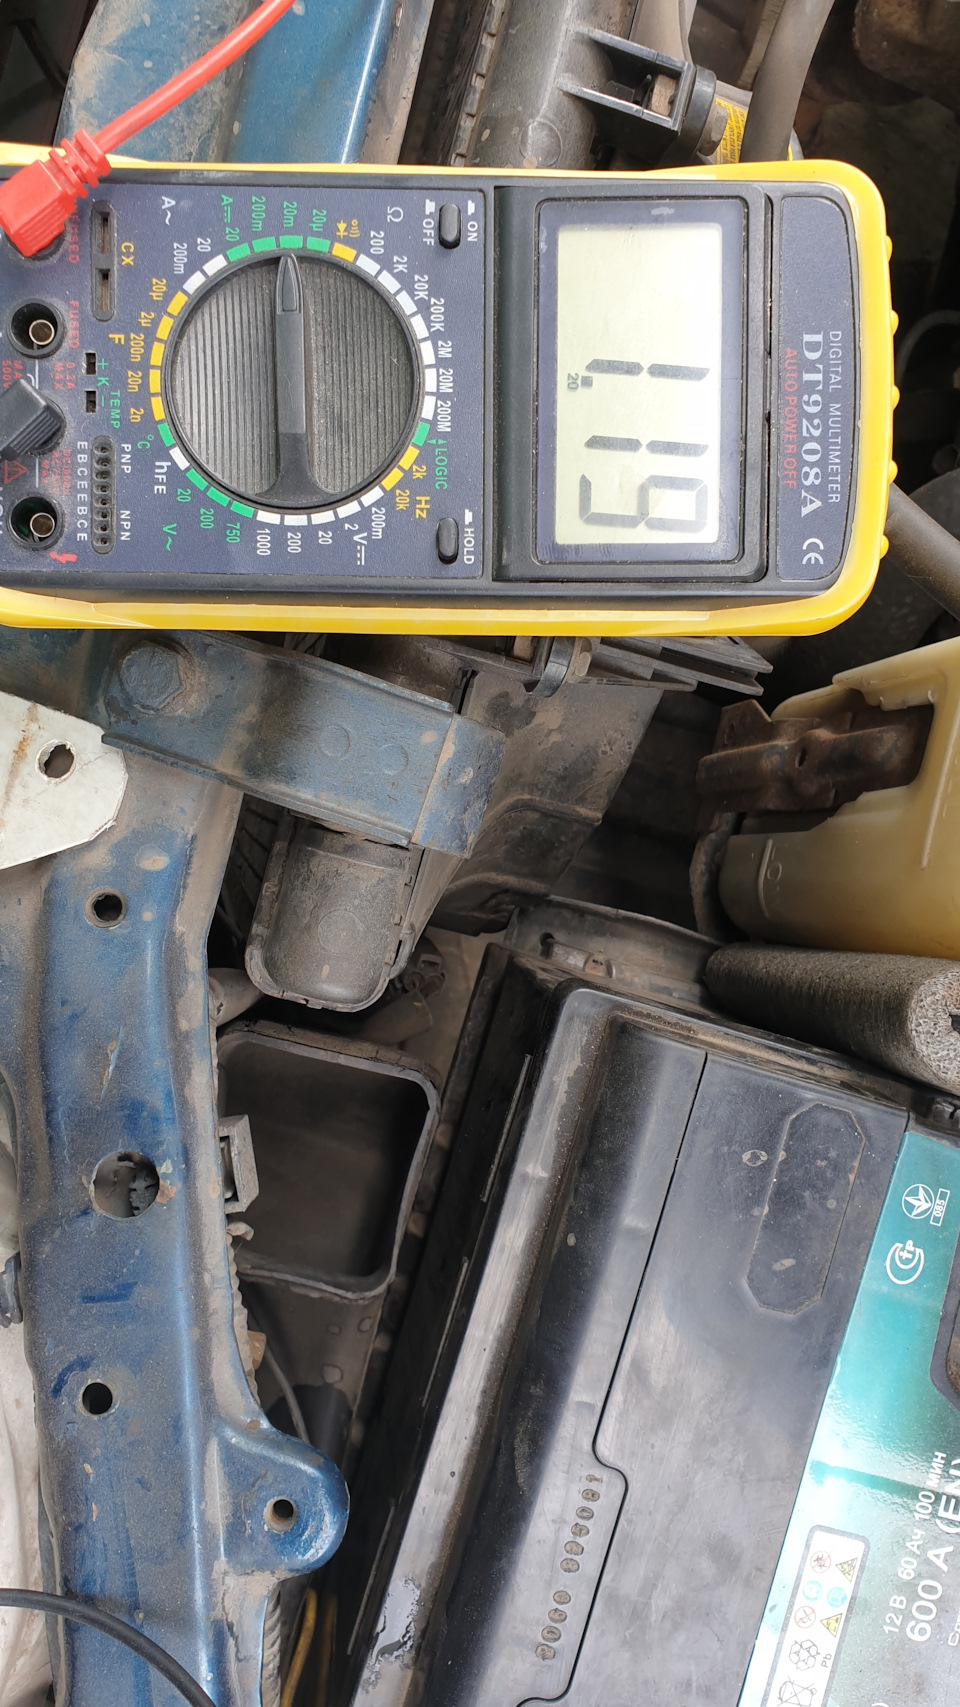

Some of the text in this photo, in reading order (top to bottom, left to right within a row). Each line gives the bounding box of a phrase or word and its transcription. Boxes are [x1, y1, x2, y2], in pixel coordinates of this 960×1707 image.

[252, 196, 266, 232] 200m
[284, 202, 297, 228] 20m
[226, 228, 240, 242] 20
[370, 230, 384, 254] 200
[423, 218, 434, 246] OFF
[467, 221, 478, 242] ON
[174, 242, 188, 274] 200m
[197, 238, 211, 252] 20
[393, 256, 408, 274] 2K
[414, 274, 428, 300] 20K
[69, 301, 80, 349] FUSED
[430, 298, 444, 332] 200K
[108, 334, 124, 345] F
[130, 334, 144, 362] 200n
[438, 340, 452, 358] 2M
[14, 360, 22, 380] MA
[128, 371, 142, 392] 20n
[439, 368, 454, 392] 20M
[567, 373, 580, 393] 20
[110, 390, 120, 429] TEMP
[130, 408, 144, 422] 2n
[437, 400, 452, 432] 200M
[784, 348, 798, 489] AUTO POWER OFF
[827, 330, 842, 503] DIGITAL MULTIMETER
[801, 331, 824, 518] DT9208A
[121, 444, 132, 474] PNP
[435, 448, 448, 490] LOGIC
[177, 488, 192, 502] 20
[416, 496, 430, 518] Hz
[120, 510, 130, 541] NPN
[200, 508, 214, 529] 200
[372, 508, 386, 540] 200m
[226, 522, 240, 544] 750
[256, 528, 270, 556] 1000
[288, 532, 302, 554] 200
[318, 531, 332, 545] 20
[464, 528, 474, 564] HOLD
[882, 1612, 903, 1634] 12
[898, 1557, 918, 1580] 60
[914, 1491, 936, 1521] 100
[906, 1580, 943, 1642] 600
[820, 1652, 832, 1668] Pb
